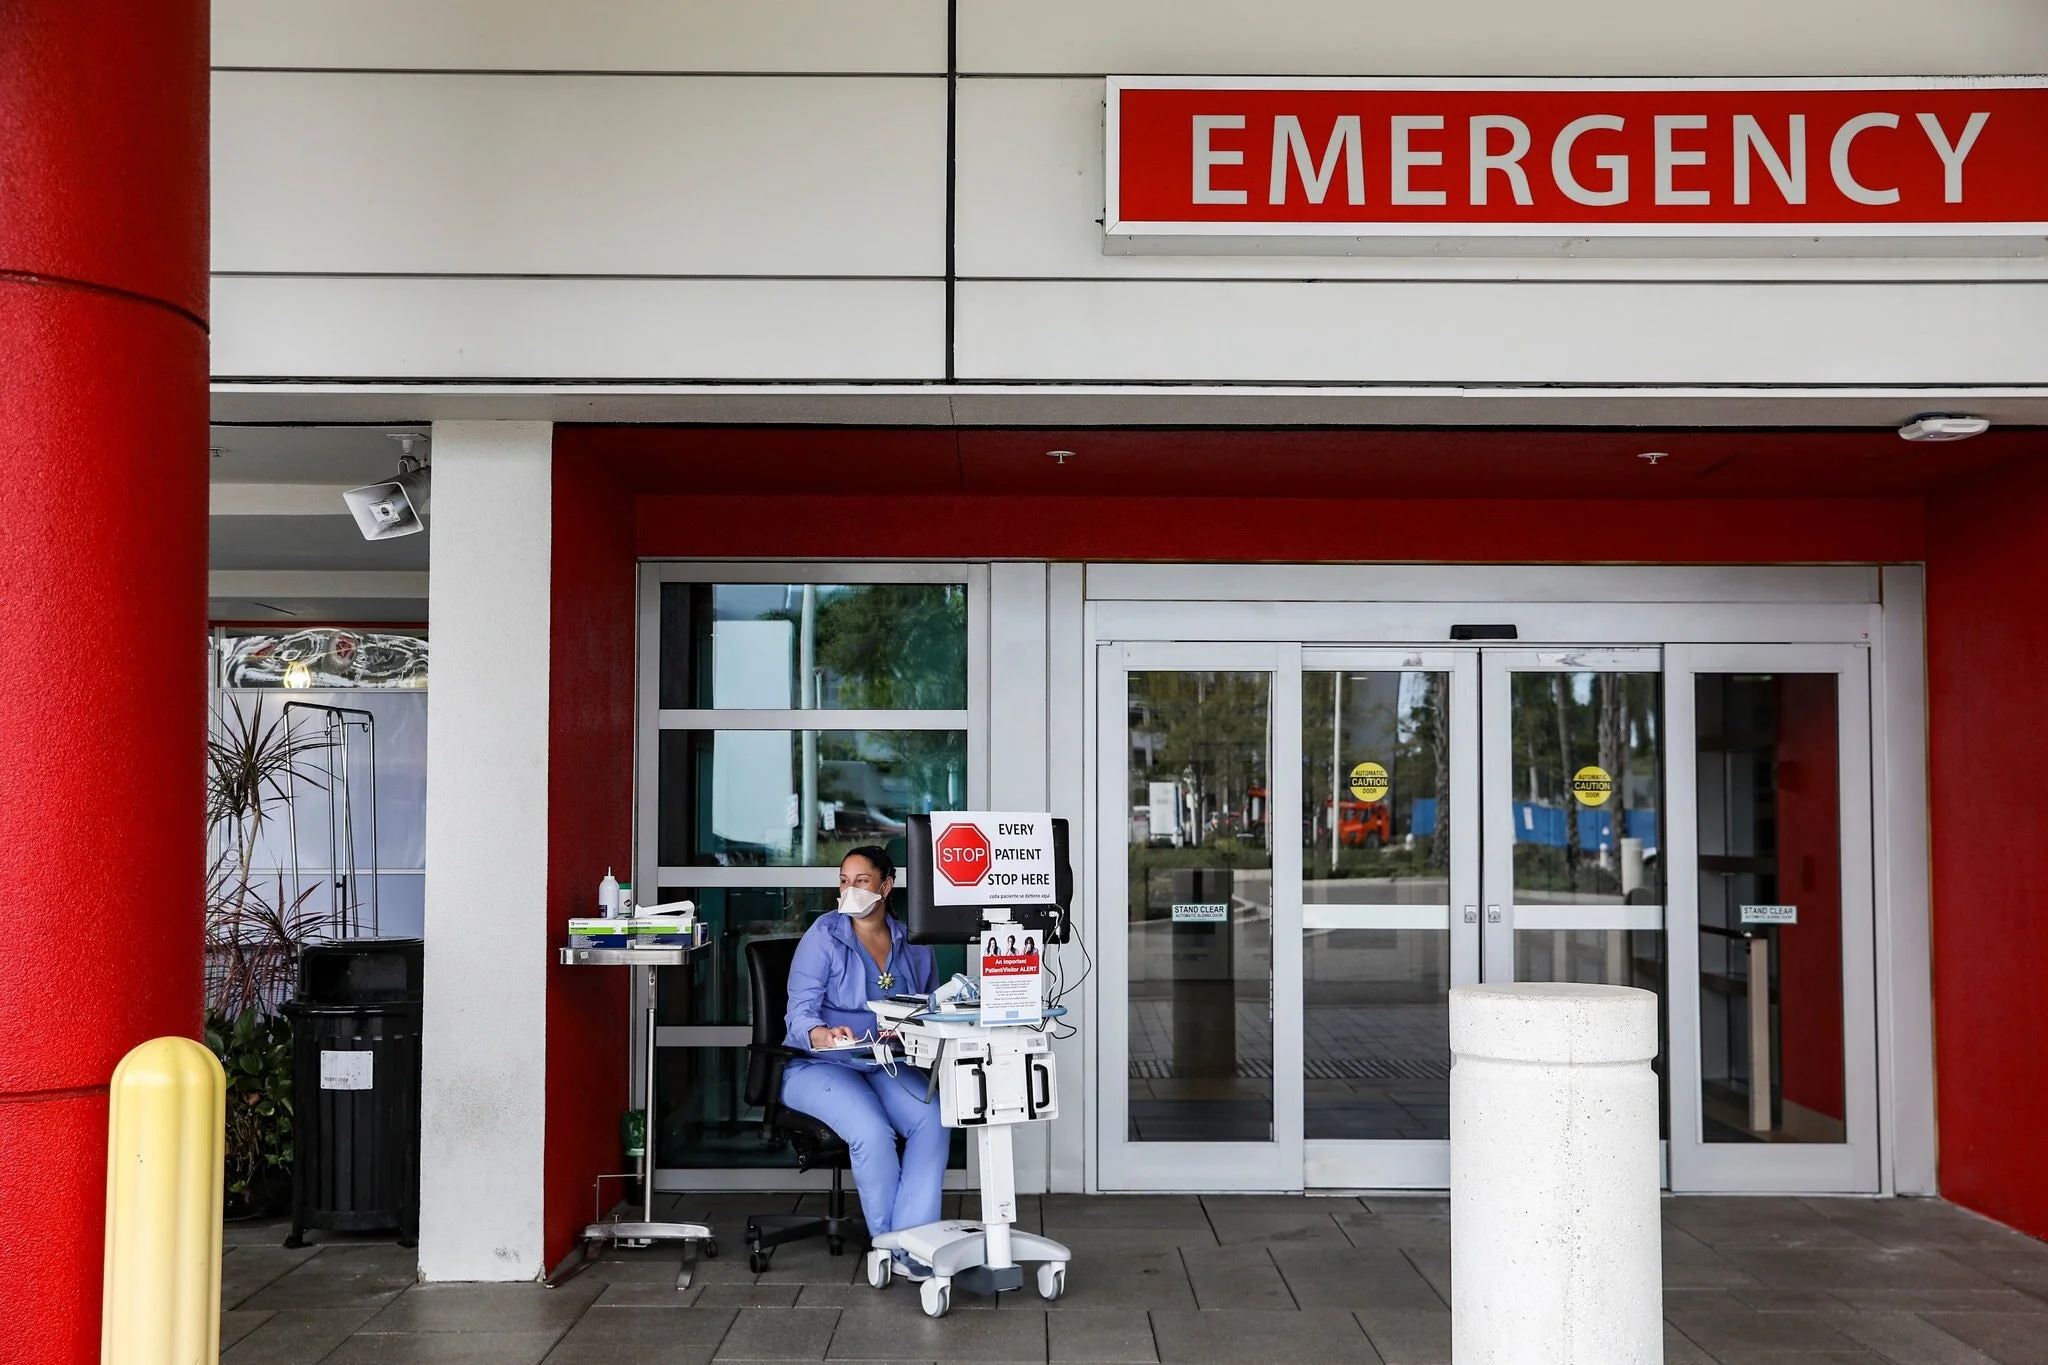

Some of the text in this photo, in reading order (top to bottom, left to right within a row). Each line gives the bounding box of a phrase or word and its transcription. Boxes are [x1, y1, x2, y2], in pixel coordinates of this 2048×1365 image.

[1191, 112, 1991, 207] EMERGENCY
[1574, 782, 1610, 790] CAUTION
[998, 823, 1035, 836] EVERY
[942, 847, 986, 863] STOP
[994, 848, 1042, 861] PATIENT
[987, 873, 1050, 886] STOP HERE
[1174, 906, 1224, 914] STAND CLEAR
[1003, 958, 1027, 966] Important
